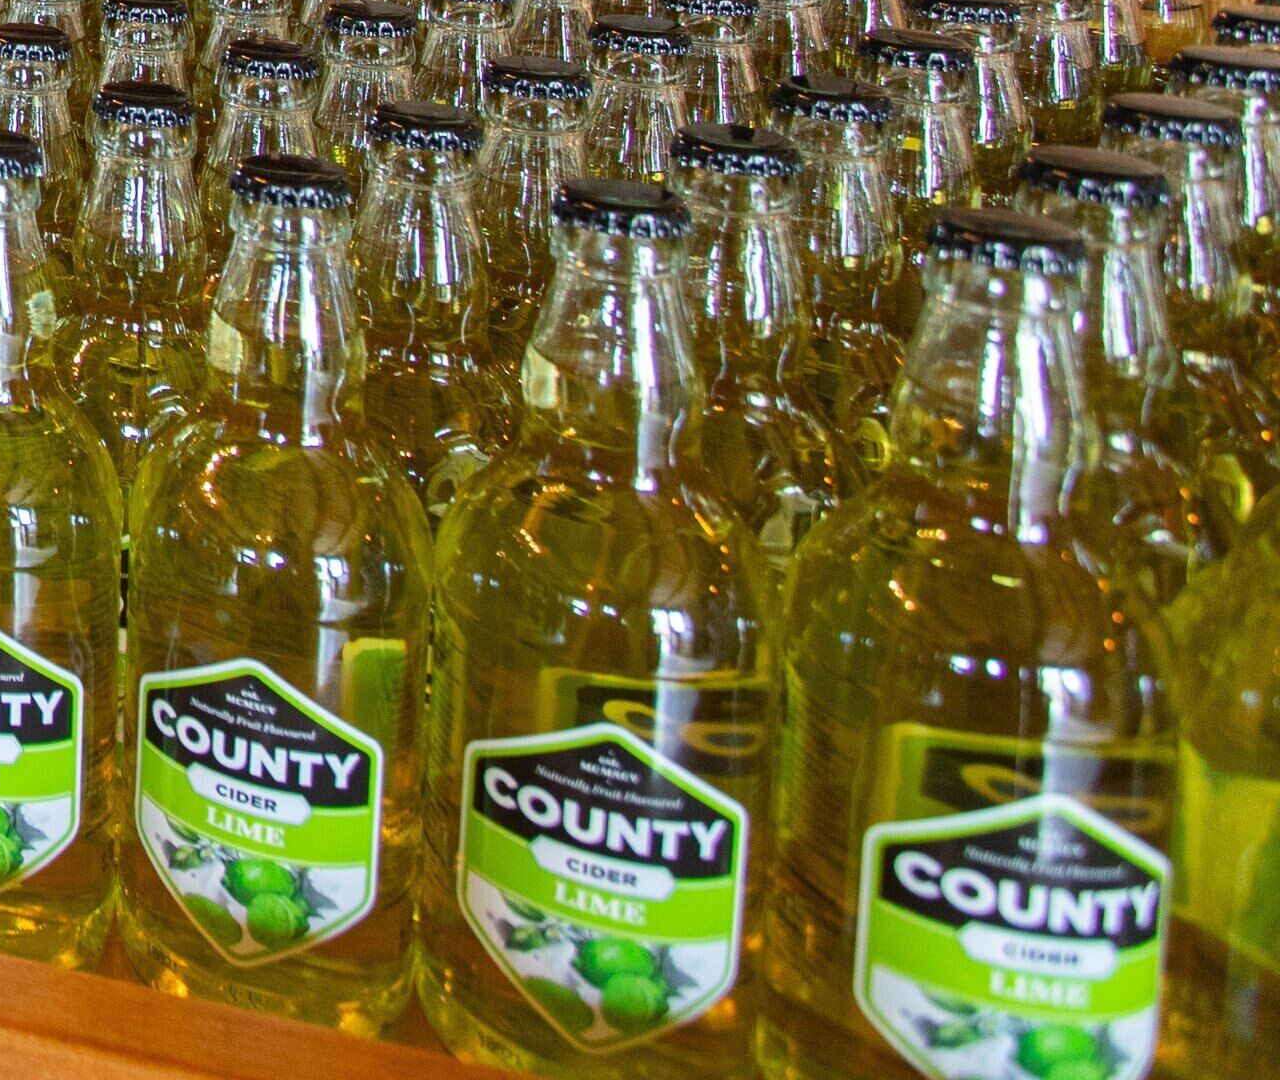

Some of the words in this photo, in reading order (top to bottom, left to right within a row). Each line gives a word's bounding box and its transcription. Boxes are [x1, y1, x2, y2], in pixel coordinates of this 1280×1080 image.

[153, 698, 360, 790] COUNTY
[215, 783, 277, 812] CIDER
[484, 766, 727, 862] COUNTY
[207, 806, 285, 848] LIME
[566, 858, 637, 887] CIDER
[894, 850, 1160, 936] COUNTY
[555, 880, 648, 927] LIME
[990, 970, 1092, 1008] LIME
